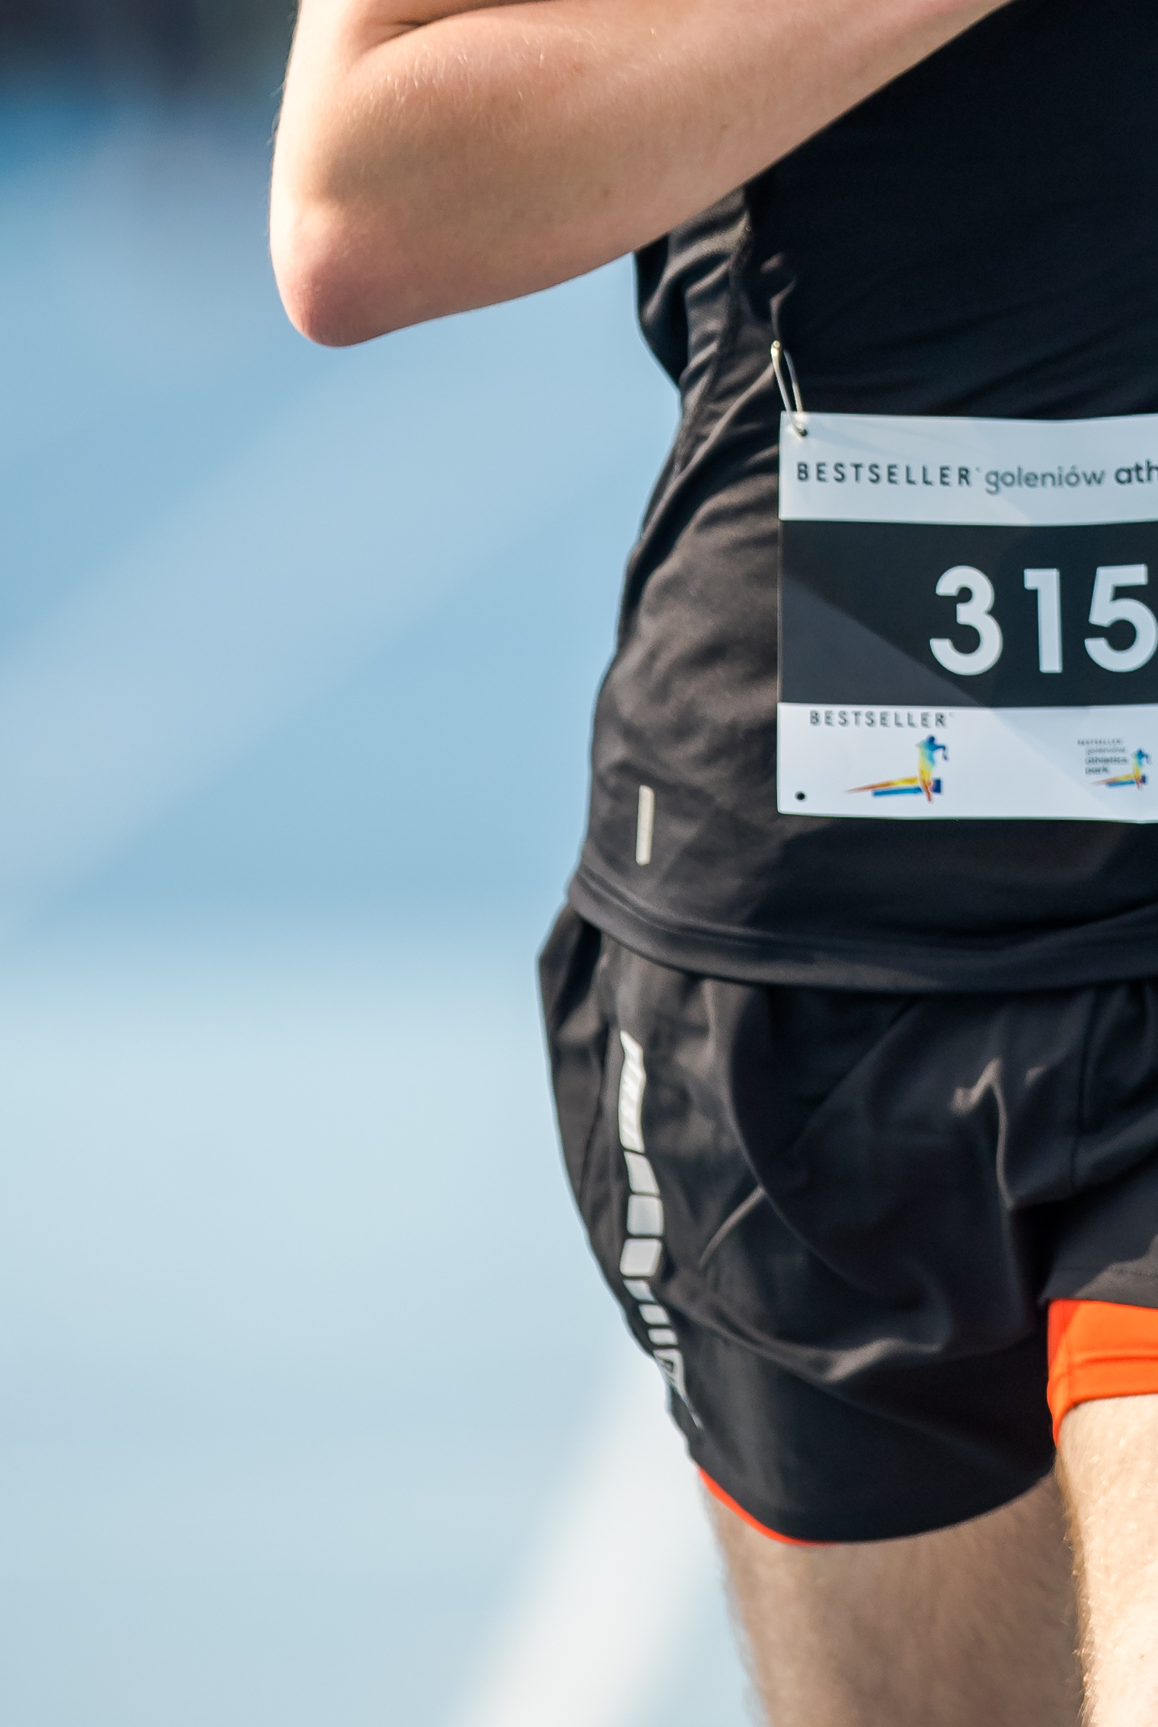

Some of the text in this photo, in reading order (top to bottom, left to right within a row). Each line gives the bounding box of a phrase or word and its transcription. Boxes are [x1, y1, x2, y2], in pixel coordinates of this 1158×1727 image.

[797, 461, 971, 487] BESTSELLER
[985, 465, 1104, 496] goleniów
[809, 710, 946, 727] BESTSELLER
